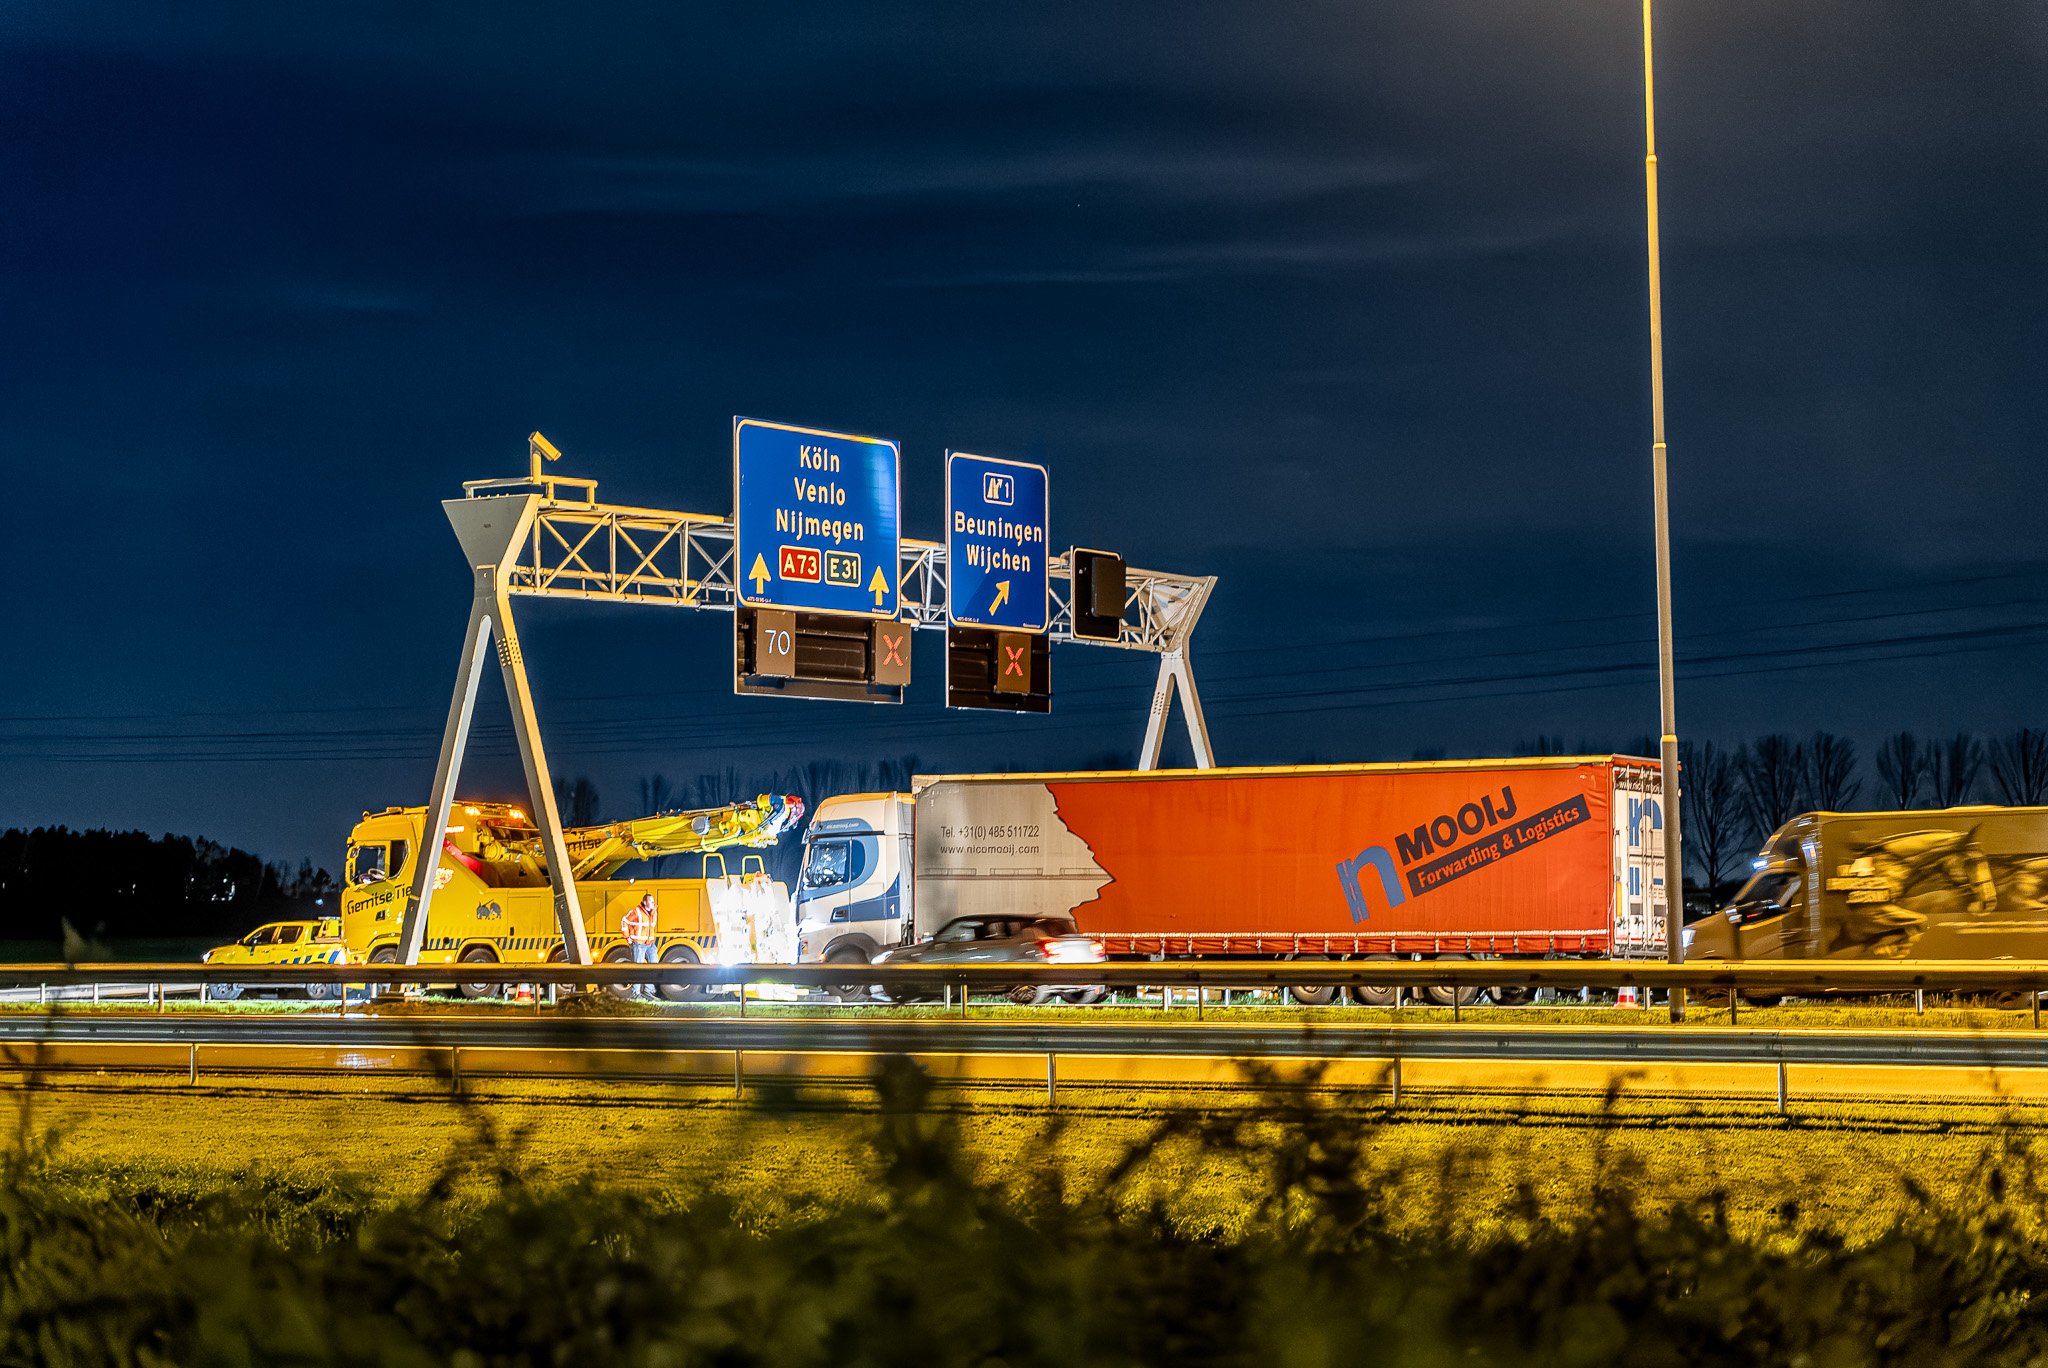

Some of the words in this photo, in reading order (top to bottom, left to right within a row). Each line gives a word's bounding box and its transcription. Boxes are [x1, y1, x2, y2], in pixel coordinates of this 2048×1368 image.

[800, 444, 840, 473] Köln
[794, 477, 846, 506] Venlo
[776, 508, 864, 545] Nijmegen
[955, 511, 1042, 545] Beuningen
[783, 554, 818, 576] A73
[966, 544, 1031, 573] Wijchen
[765, 629, 791, 656] 70
[940, 826, 956, 838] Tel.
[958, 825, 987, 840] +31(0)
[988, 825, 1006, 838] 485
[1007, 825, 1040, 838] 511722
[1395, 786, 1518, 867] MOOIJ
[940, 844, 1040, 857] www.nicomooij.com
[1417, 843, 1499, 888] Forwarding
[1502, 835, 1515, 850] &
[1516, 806, 1580, 843] Logistics
[347, 891, 393, 915] Gerritse
[889, 903, 895, 915] 1
